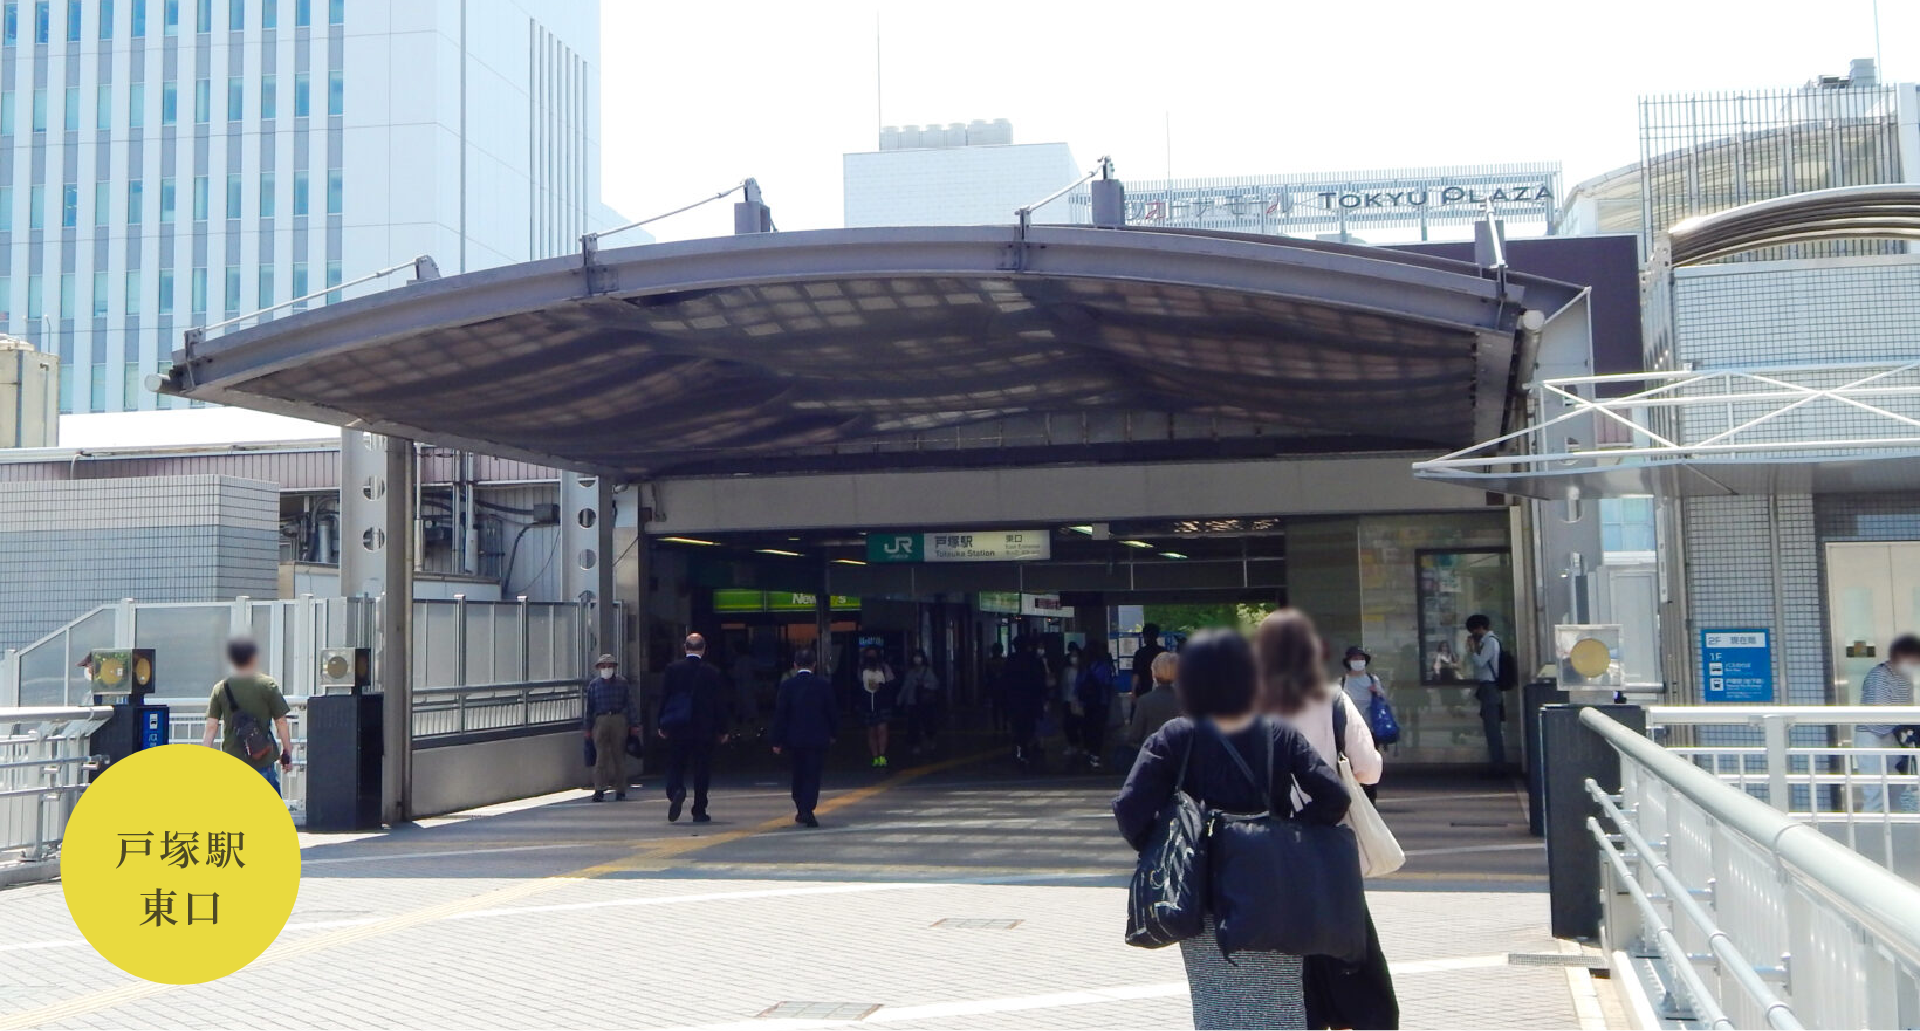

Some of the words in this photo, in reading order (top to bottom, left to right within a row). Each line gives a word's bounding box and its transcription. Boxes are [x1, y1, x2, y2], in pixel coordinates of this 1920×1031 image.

[1318, 191, 1428, 209] TOKYU
[1442, 187, 1554, 204] PLAZA
[934, 535, 973, 548] 戸塚駅
[1006, 534, 1023, 543] 東口
[884, 536, 913, 554] JR
[967, 549, 995, 557] Station
[1709, 652, 1722, 661] 1F
